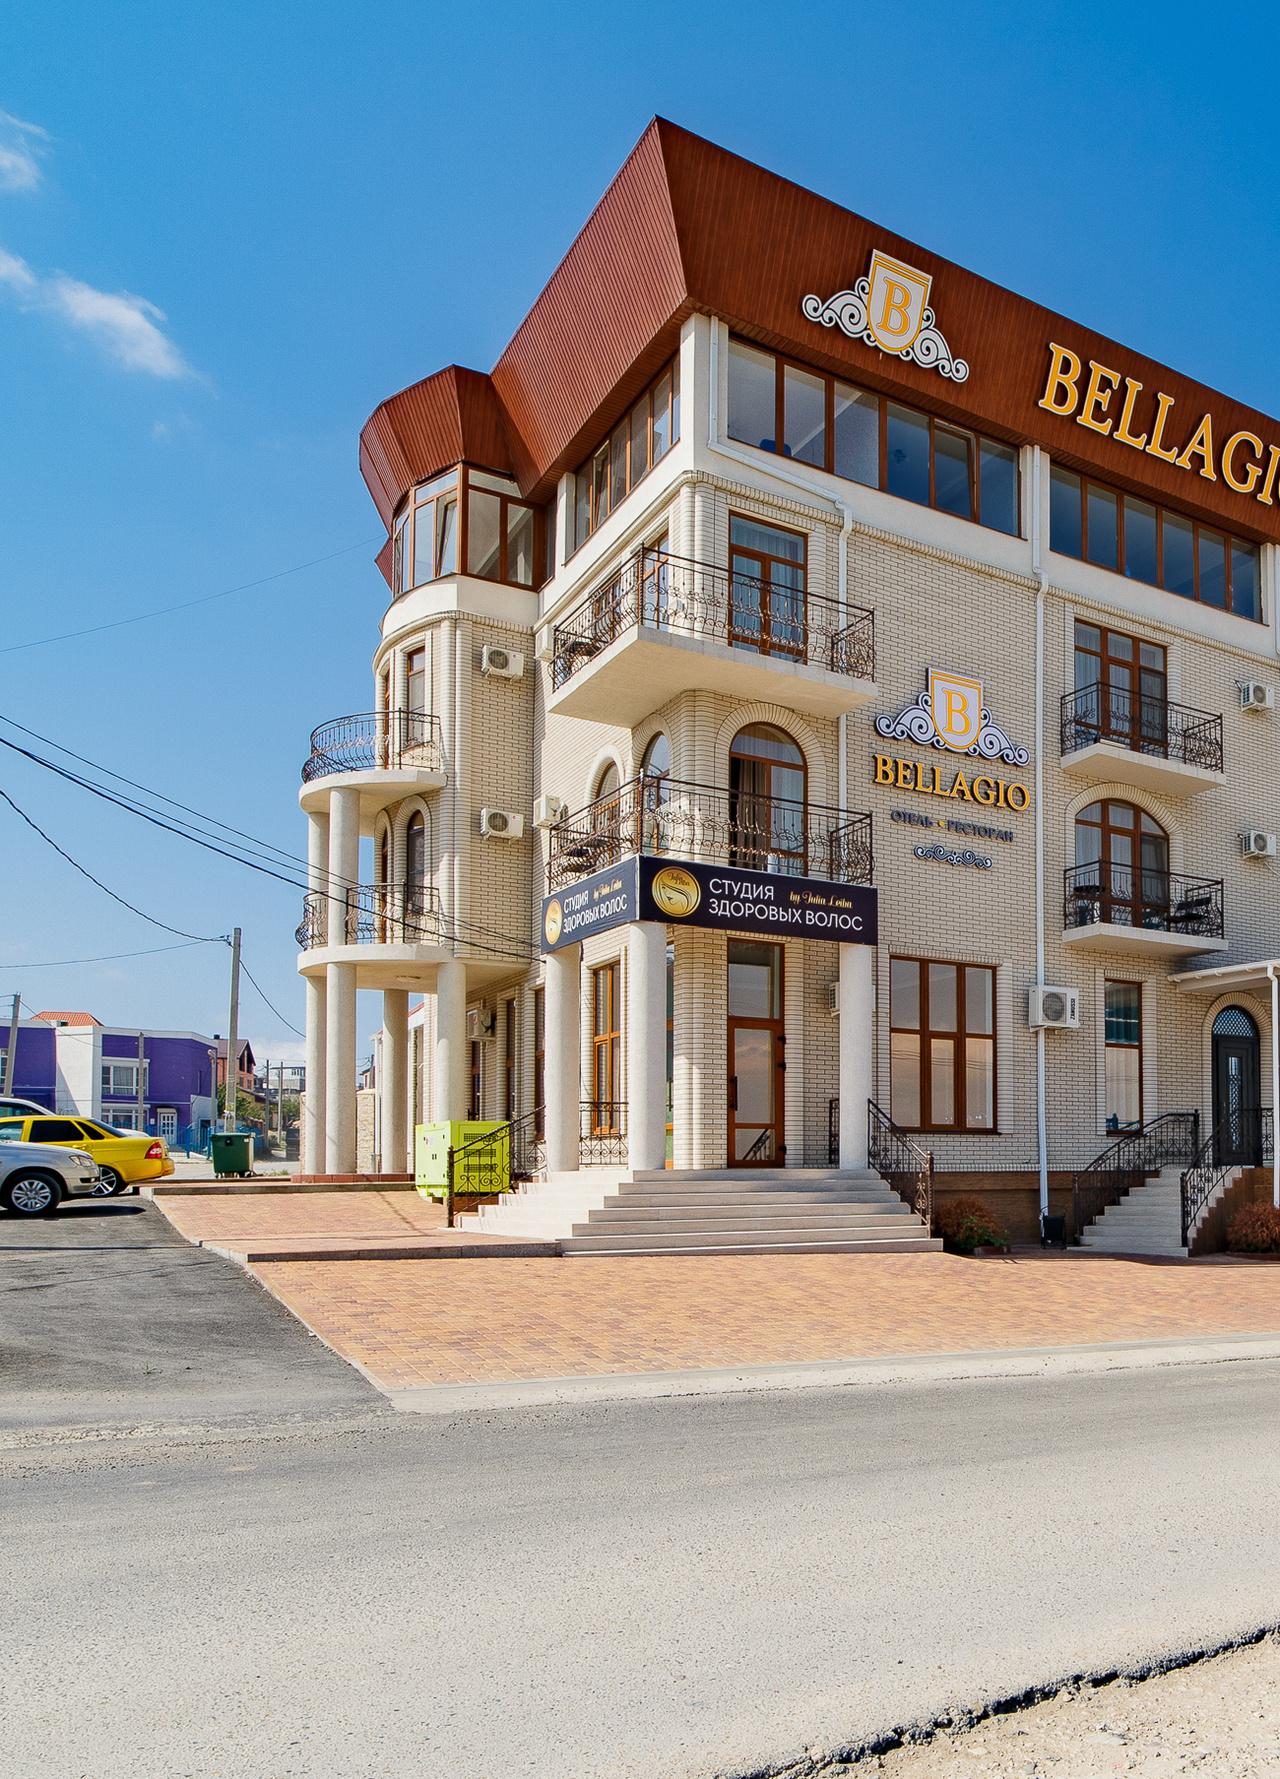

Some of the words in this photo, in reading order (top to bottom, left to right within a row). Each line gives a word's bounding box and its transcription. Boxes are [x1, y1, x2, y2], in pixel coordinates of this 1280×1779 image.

[876, 277, 911, 336] B
[942, 688, 972, 735] B
[874, 753, 1031, 812] BELLAGIO
[890, 809, 934, 828] ОТЕЛЬ
[947, 819, 1014, 843] РЕСТОРАН
[563, 890, 589, 914] СТУДИЯ
[709, 878, 775, 901] СТУДИЯ
[789, 890, 800, 905] by
[562, 904, 600, 934] ЗДОРОВЫХ
[600, 893, 628, 919] ВОЛОС
[708, 898, 803, 925] ЗДОРОВЫХ
[805, 910, 864, 932] ВОЛОС
